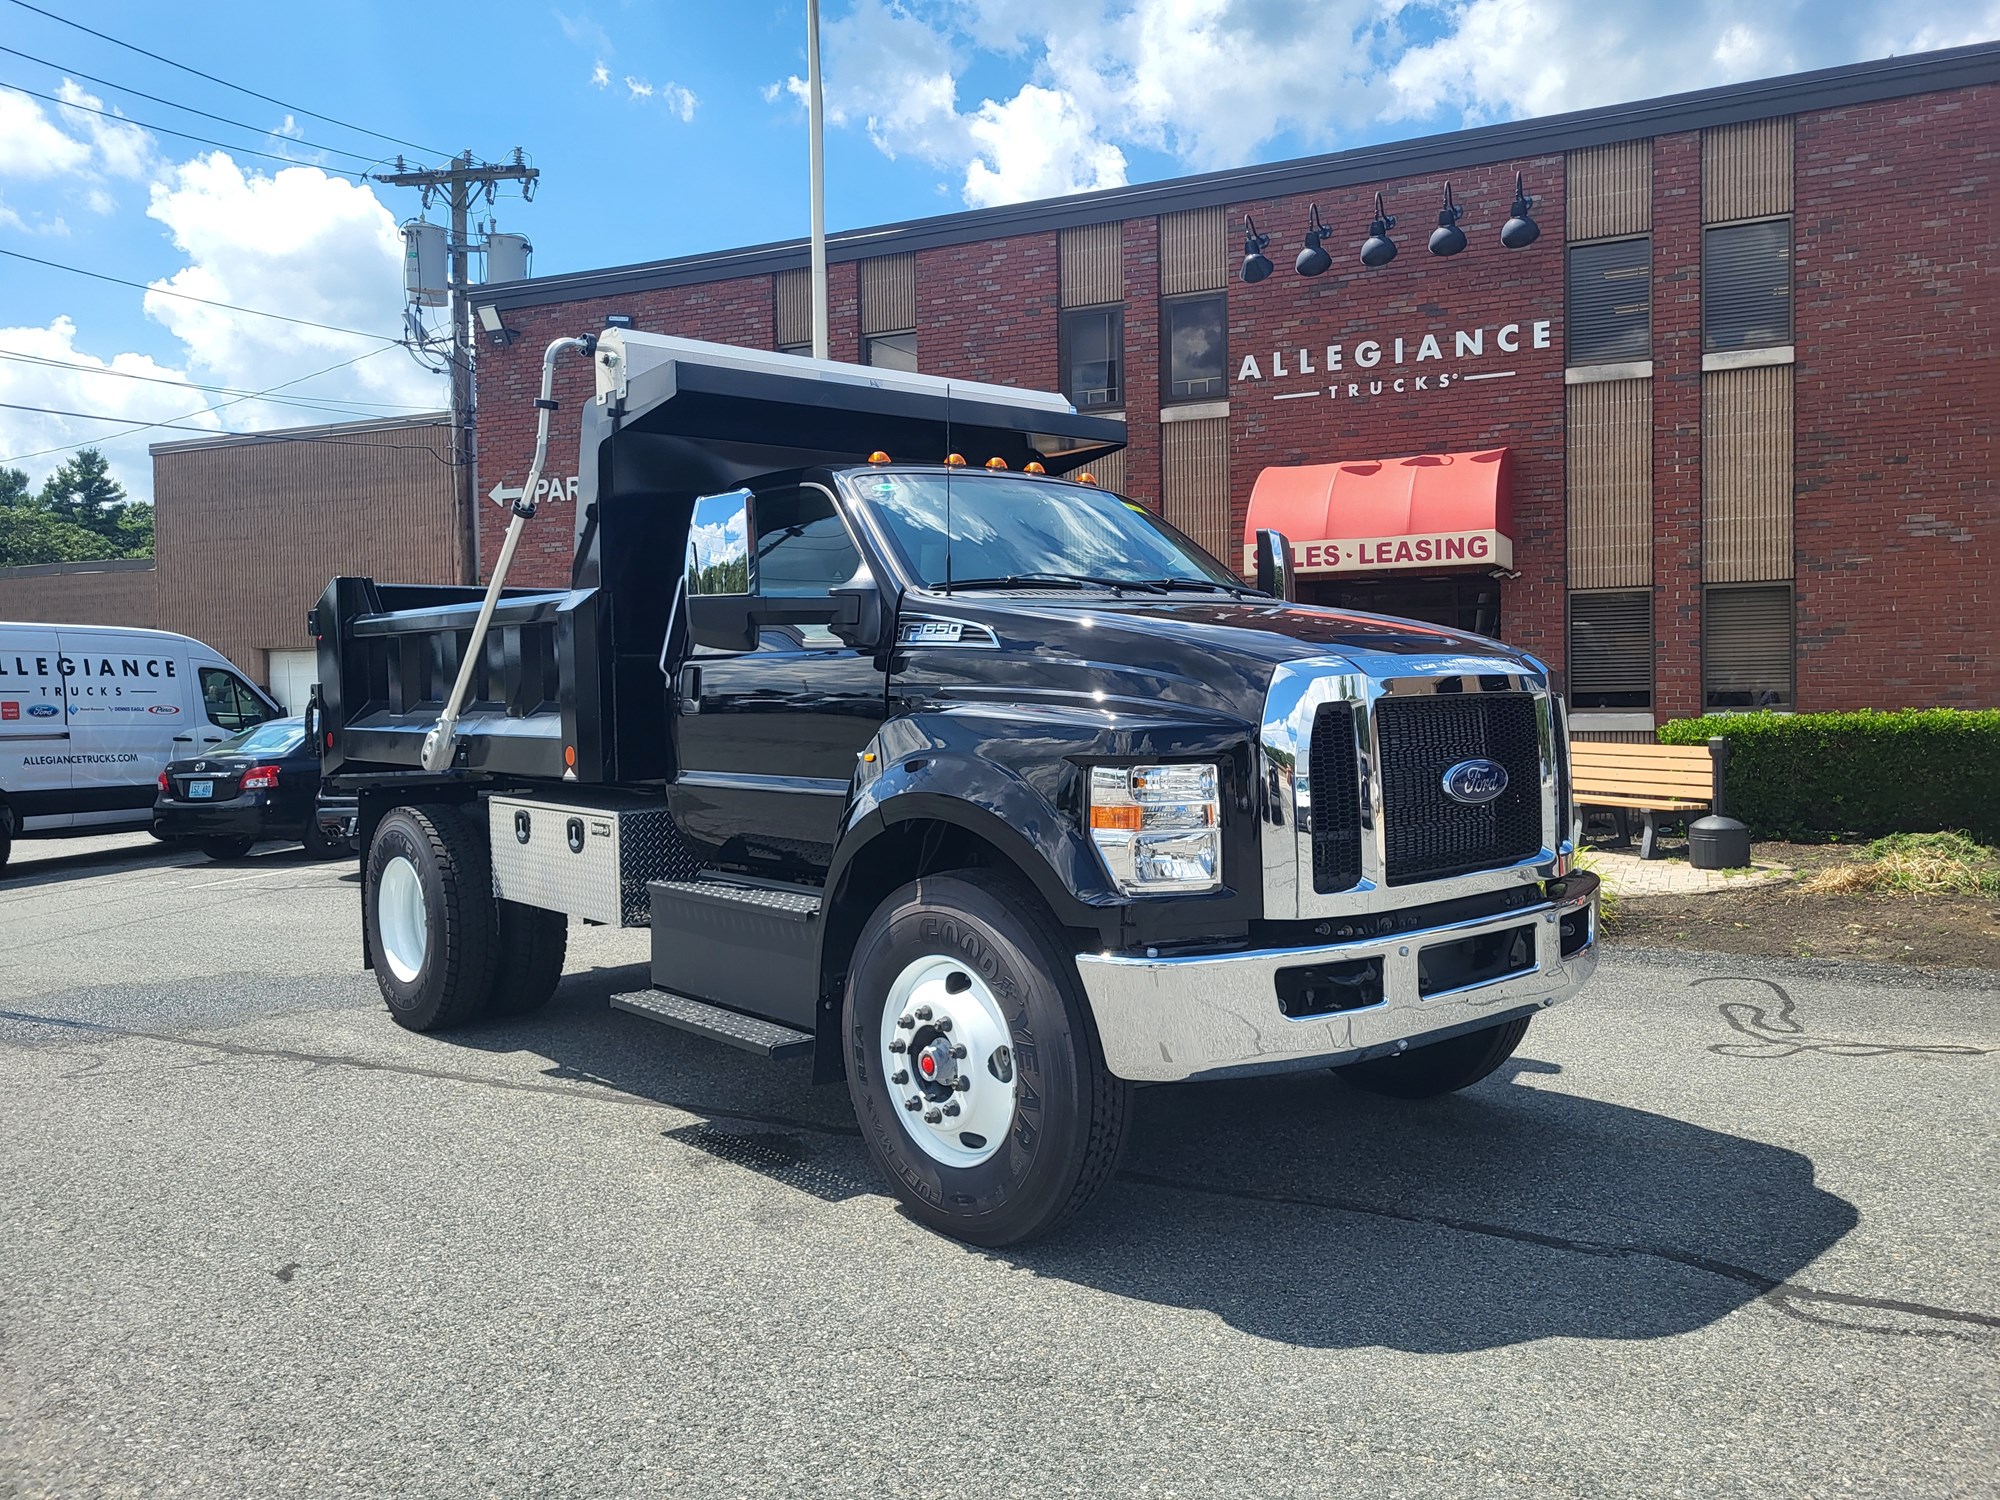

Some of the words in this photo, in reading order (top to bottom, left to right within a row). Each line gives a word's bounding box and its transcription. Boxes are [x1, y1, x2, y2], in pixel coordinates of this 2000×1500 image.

[1237, 320, 1551, 381] ALLEGIANCE
[1252, 545, 1340, 570] LES
[1359, 535, 1489, 565] LEASING
[40, 686, 123, 697] TRUCKS
[23, 753, 139, 766] ALLEGIANCETRUCKS.COM
